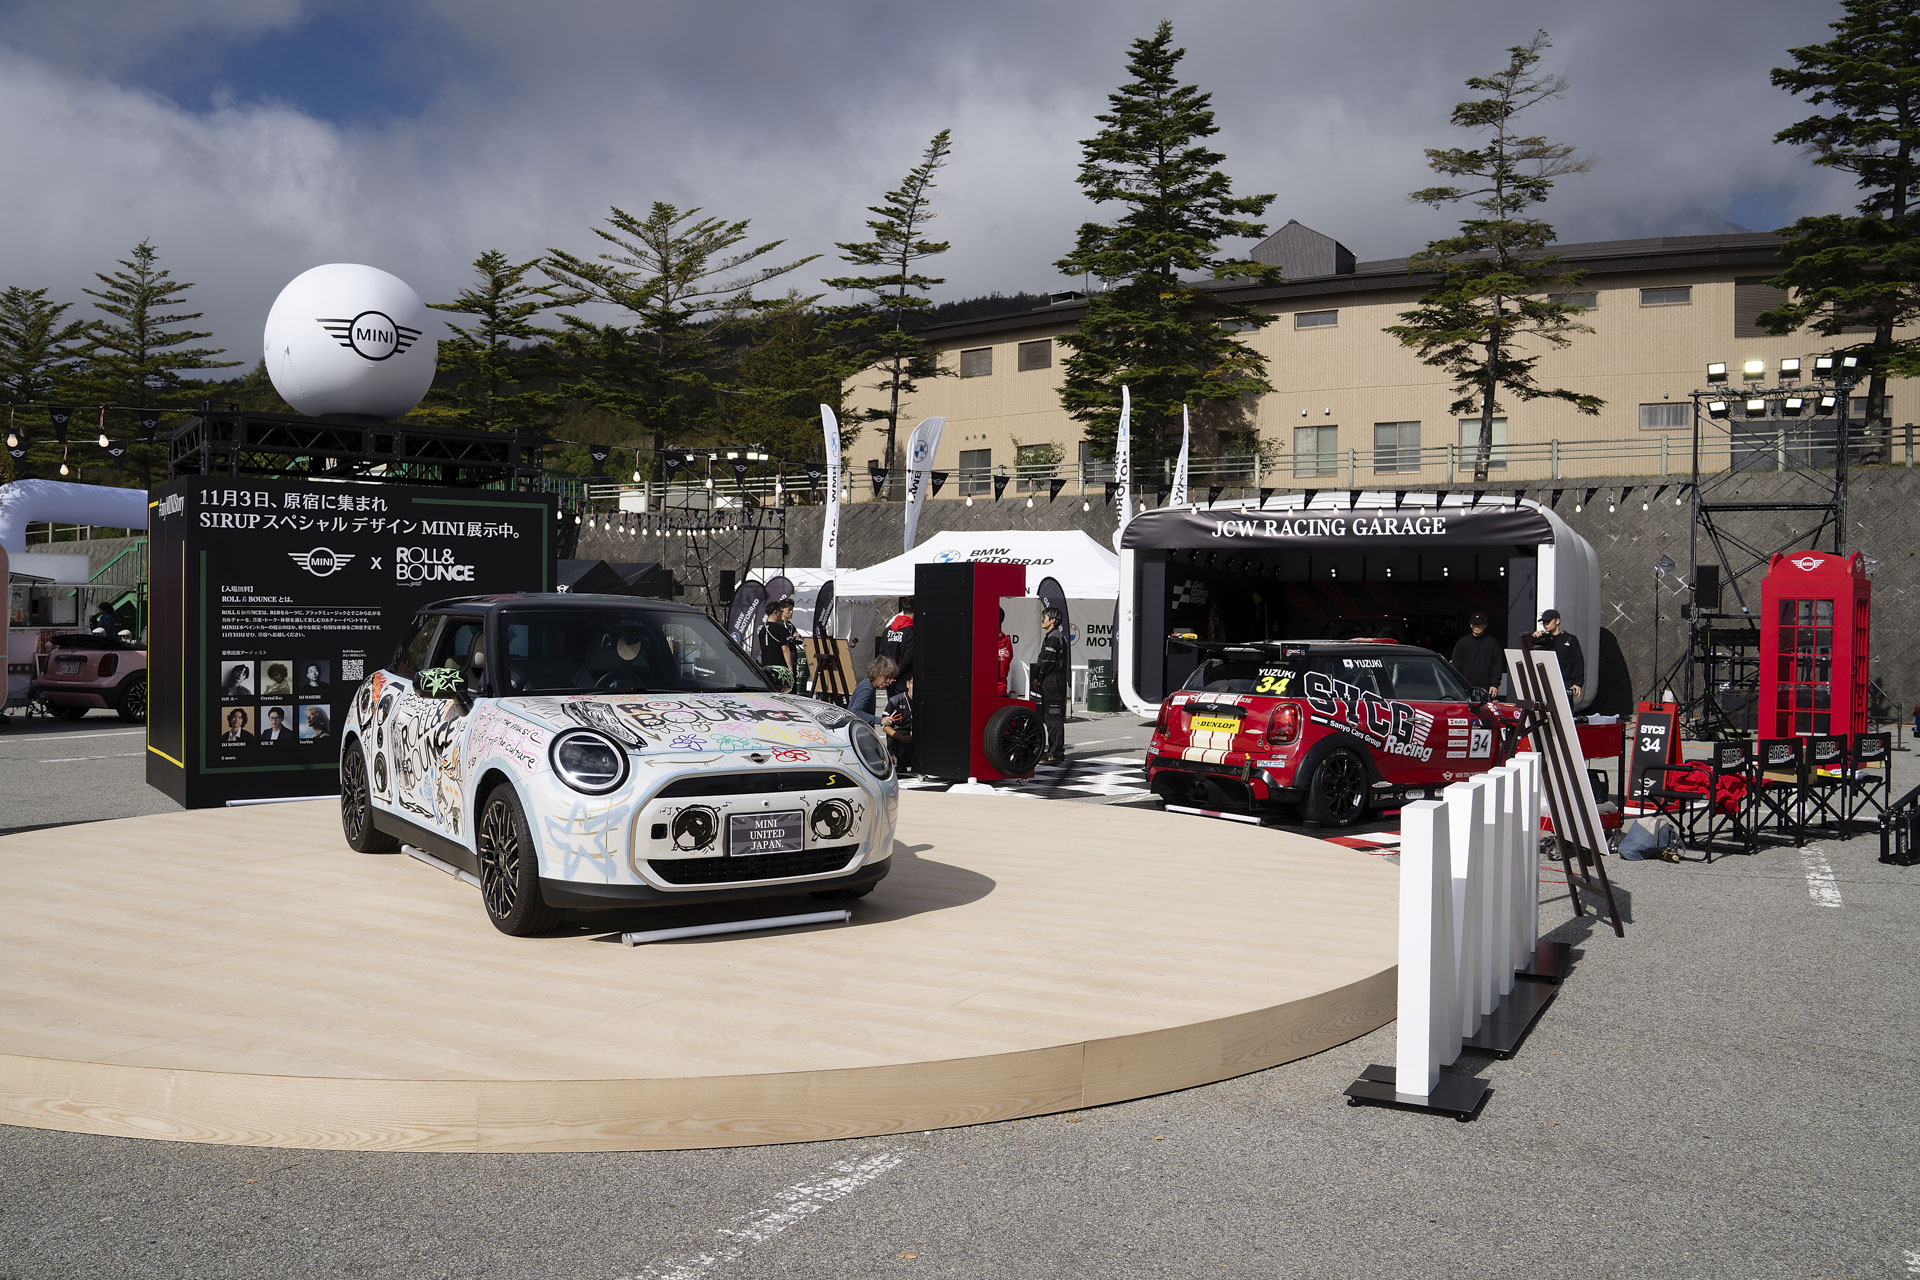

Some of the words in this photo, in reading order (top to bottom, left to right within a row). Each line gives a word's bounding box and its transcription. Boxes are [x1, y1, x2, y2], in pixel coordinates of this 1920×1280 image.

[356, 327, 394, 345] MINI
[199, 488, 388, 512] 11月3日、原宿に集まれ
[199, 511, 349, 532] SIRUPスペシャル
[351, 517, 418, 536] デザイン
[421, 520, 521, 540] MINI展示中。
[1211, 519, 1259, 538] JCW
[1264, 517, 1347, 538] RACING
[1352, 516, 1447, 536] GARAGE
[969, 548, 1011, 557] BMW
[311, 557, 333, 567] MINI
[396, 563, 475, 582] BOUNCE
[221, 595, 242, 603] ROLL
[734, 611, 745, 630] BMW
[738, 598, 760, 634] MOTORRAD
[1353, 658, 1384, 669] YUZUKI
[1258, 668, 1297, 680] YUZUKI
[1255, 676, 1291, 695] 34
[1303, 670, 1416, 745] SYCG
[632, 708, 813, 729] BOUNCE
[1200, 720, 1236, 729] DUNLOP
[1329, 719, 1351, 734] Sanyo
[1350, 728, 1365, 740] Cars
[1364, 734, 1382, 748] Group
[1640, 724, 1666, 735] SYCG
[1383, 734, 1434, 763] Racing
[1471, 732, 1491, 753] 34
[1640, 737, 1661, 753] 34
[825, 774, 837, 786] S
[755, 819, 778, 830] MINI
[749, 828, 786, 841] UNITED
[750, 839, 785, 851] JAPAN.
